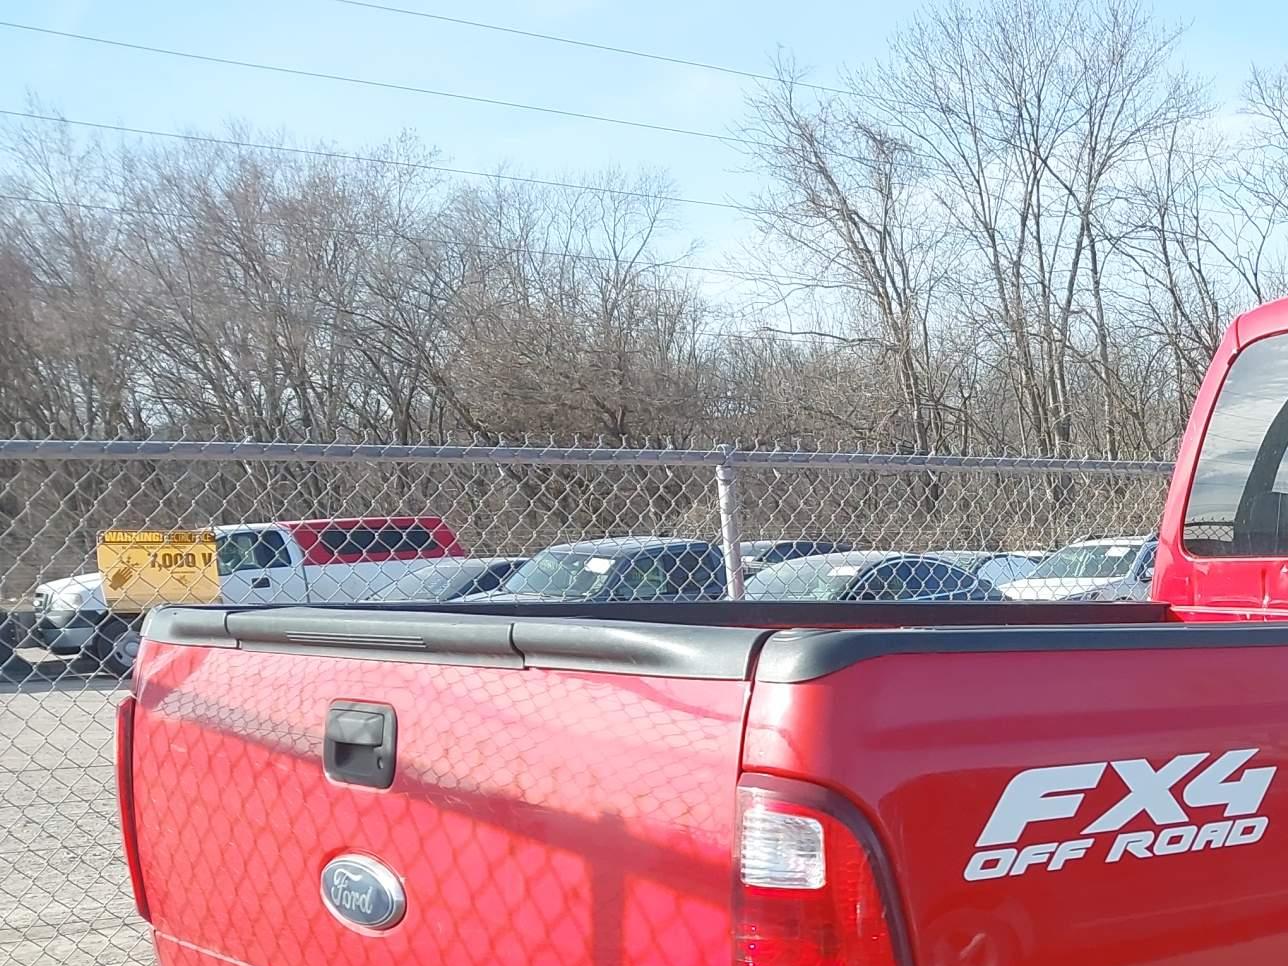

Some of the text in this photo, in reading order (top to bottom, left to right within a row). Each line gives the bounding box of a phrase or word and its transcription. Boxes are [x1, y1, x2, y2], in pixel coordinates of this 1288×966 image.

[974, 748, 1278, 847] FX4
[963, 816, 1270, 882] OFF ROAD
[331, 868, 373, 914] Ford
